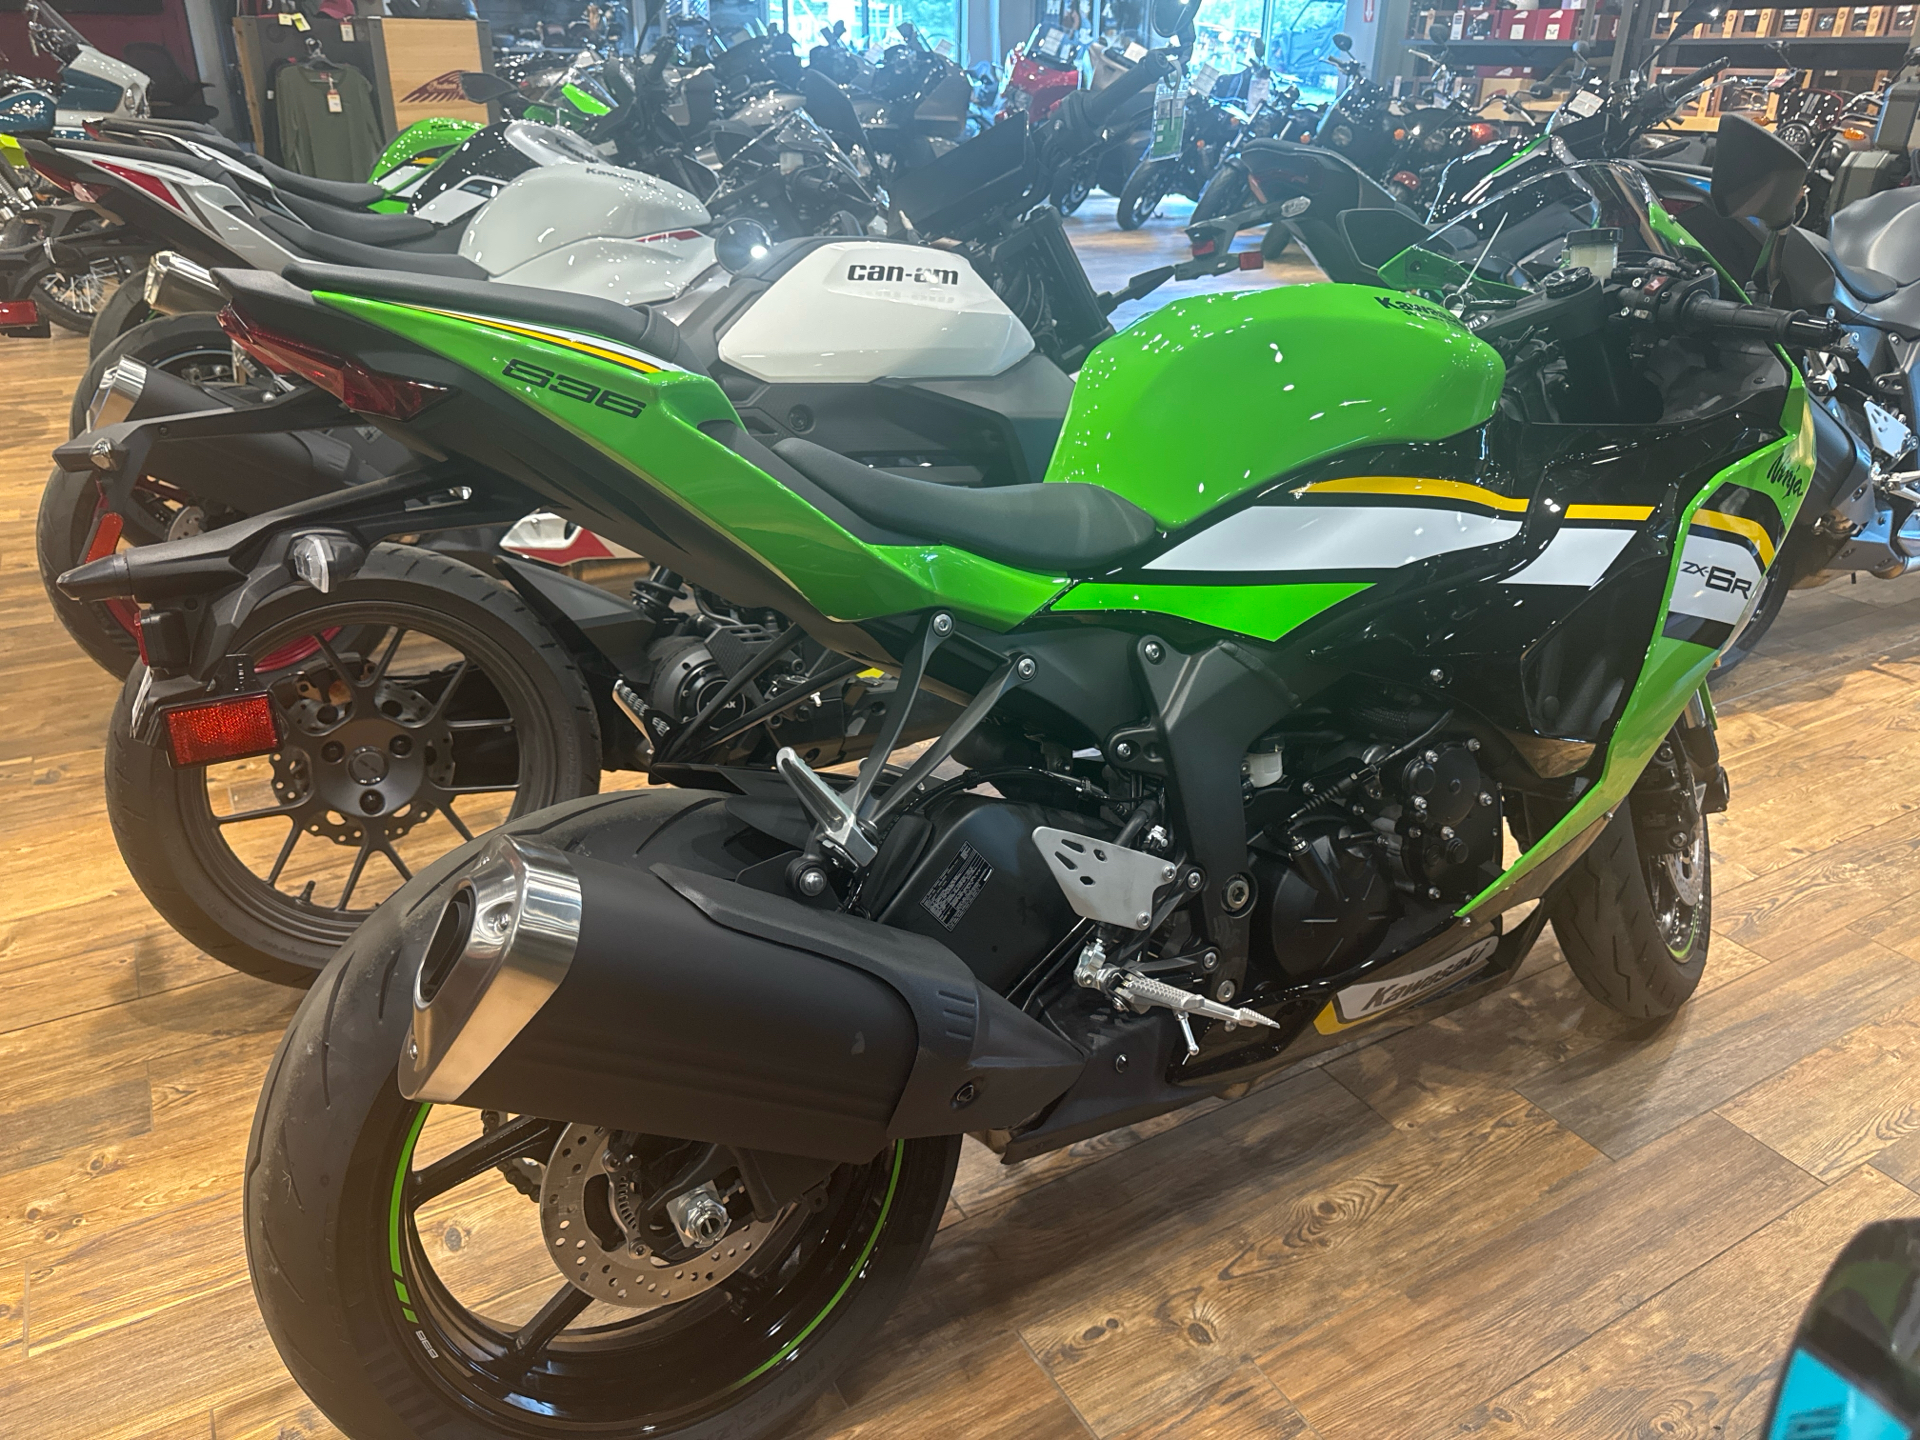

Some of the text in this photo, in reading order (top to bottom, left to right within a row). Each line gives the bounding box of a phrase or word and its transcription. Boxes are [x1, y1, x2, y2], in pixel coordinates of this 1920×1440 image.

[846, 263, 960, 286] can-am
[501, 357, 648, 420] 636
[1766, 451, 1804, 500] Ninja
[1679, 560, 1753, 600] ZX-6R
[1360, 940, 1491, 1012] Kawasaki
